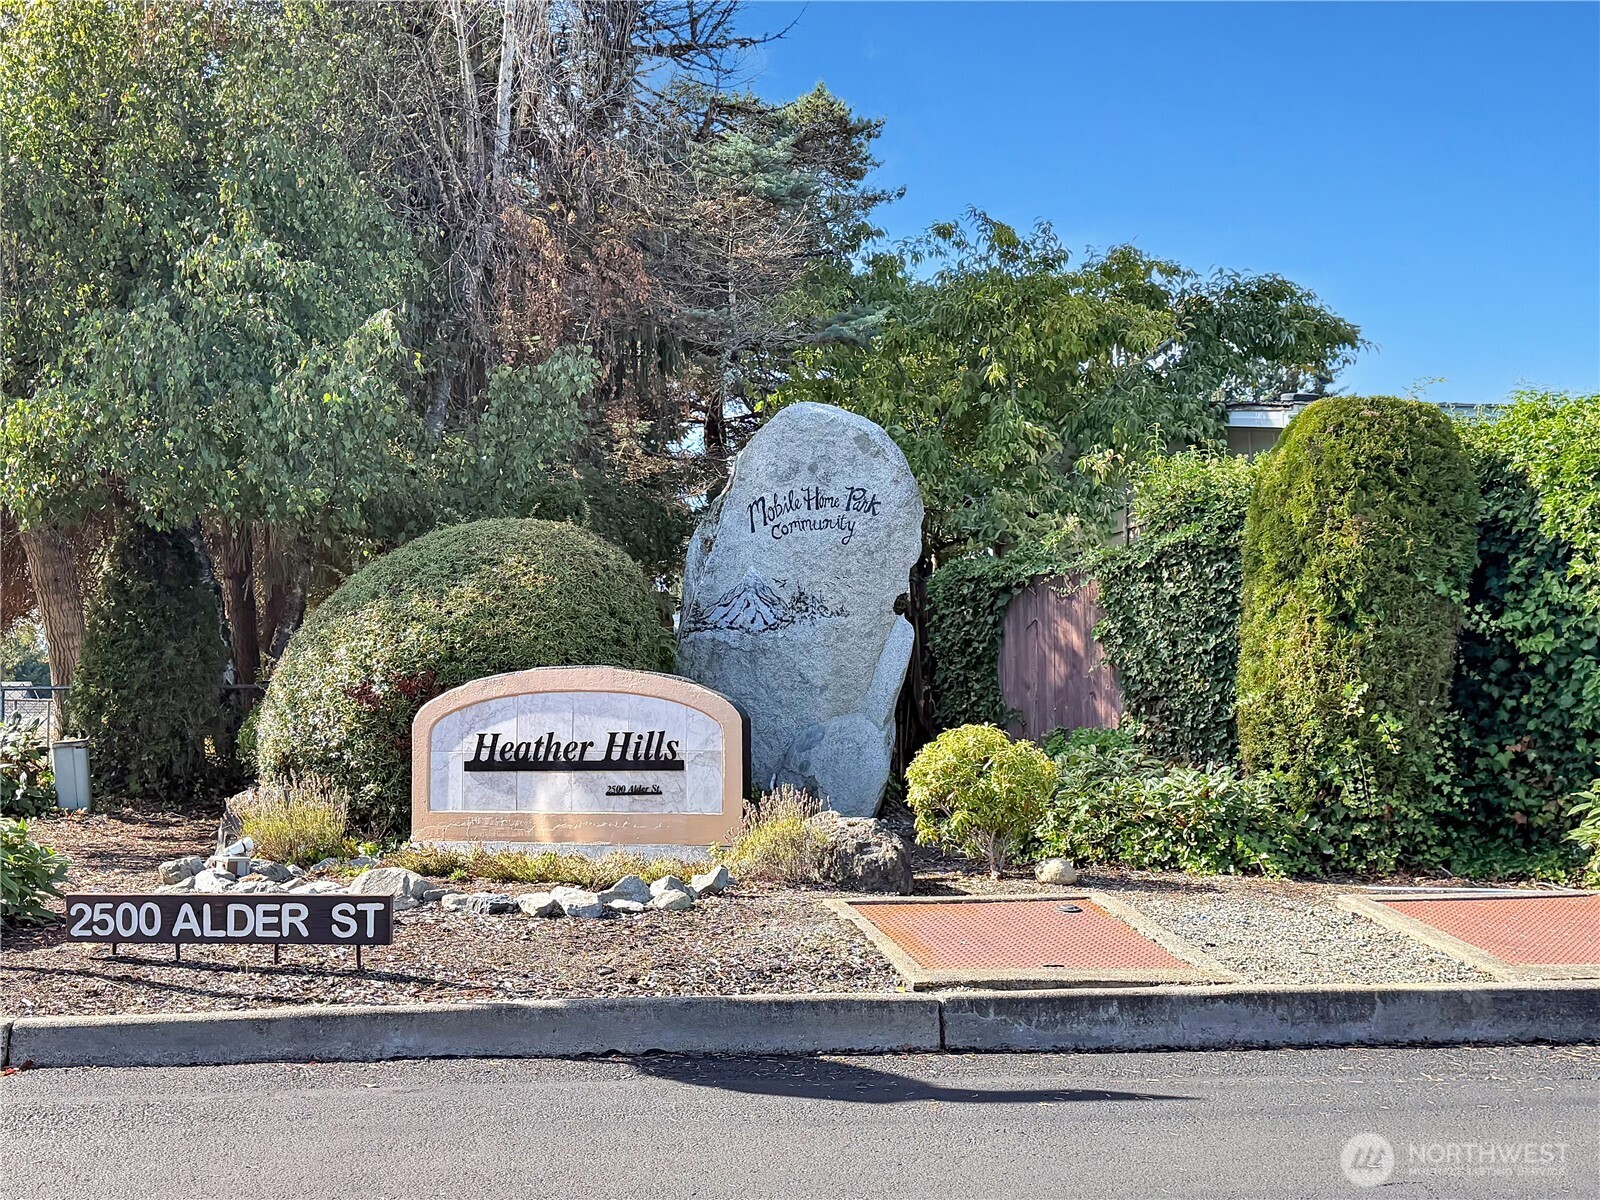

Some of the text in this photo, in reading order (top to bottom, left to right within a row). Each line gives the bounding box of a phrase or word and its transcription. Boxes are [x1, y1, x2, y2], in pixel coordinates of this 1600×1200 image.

[745, 486, 882, 533] Mobile Home Park
[471, 730, 680, 762] Heather Hills
[606, 784, 626, 794] 2500
[627, 784, 649, 794] Alder
[70, 901, 385, 938] 2500 ALDER ST
